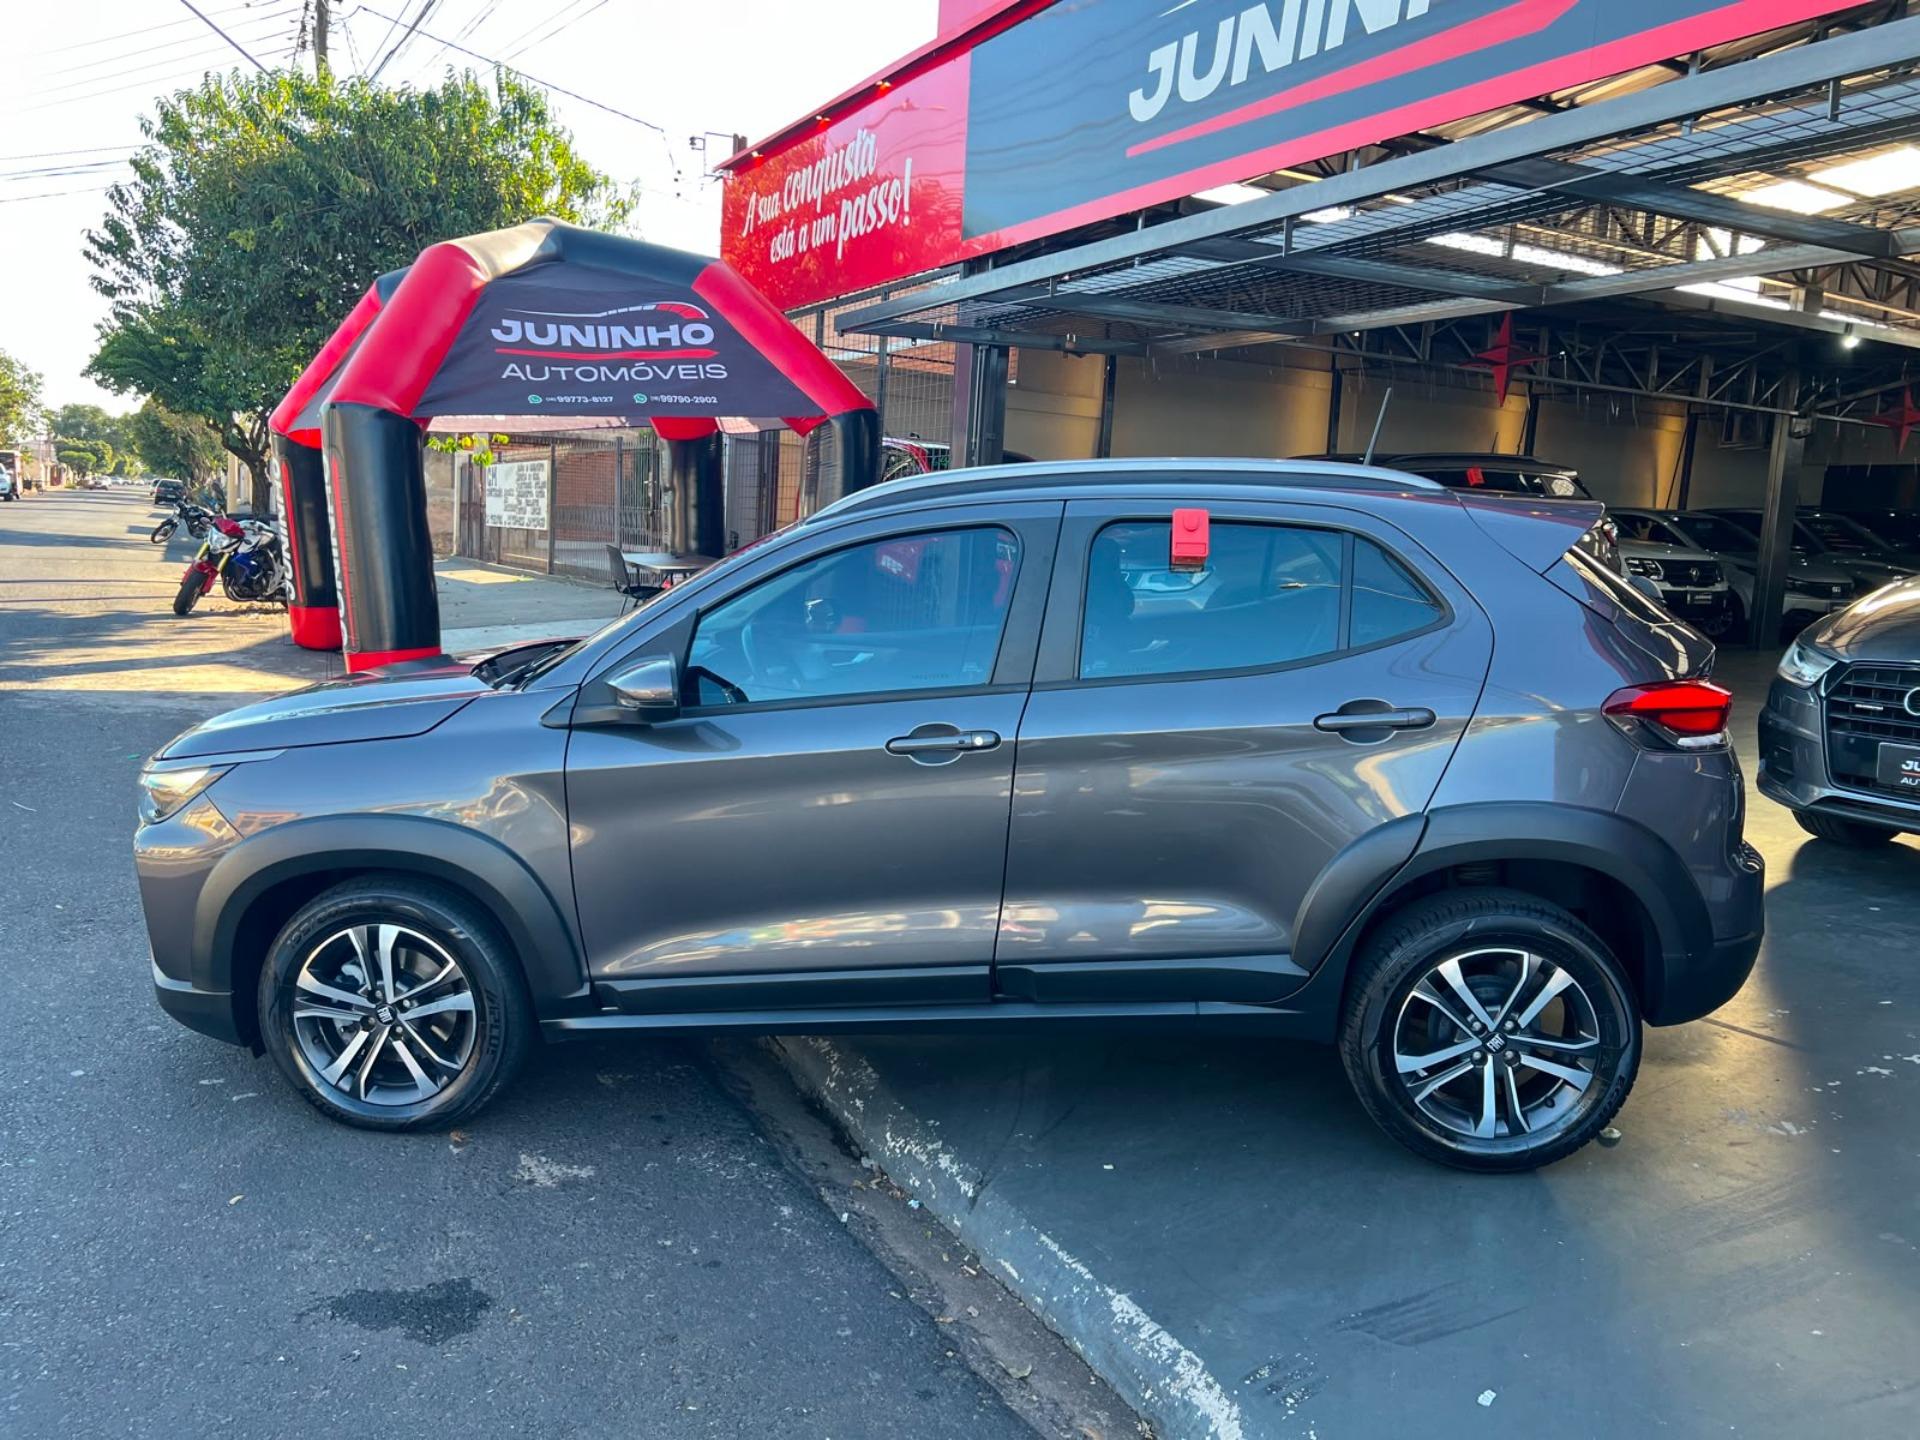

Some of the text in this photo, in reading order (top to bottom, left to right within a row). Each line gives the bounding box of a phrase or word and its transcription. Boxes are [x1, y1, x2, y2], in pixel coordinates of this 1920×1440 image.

[1129, 0, 1429, 122] JUNIN
[742, 191, 757, 238] A
[758, 191, 780, 225] sua
[770, 157, 912, 264] está a um passo!
[491, 318, 715, 348] JUNINHO
[501, 362, 728, 382] AUTOMÓVEIS
[1900, 777, 1920, 786] AU
[1486, 1033, 1505, 1052] FIAT
